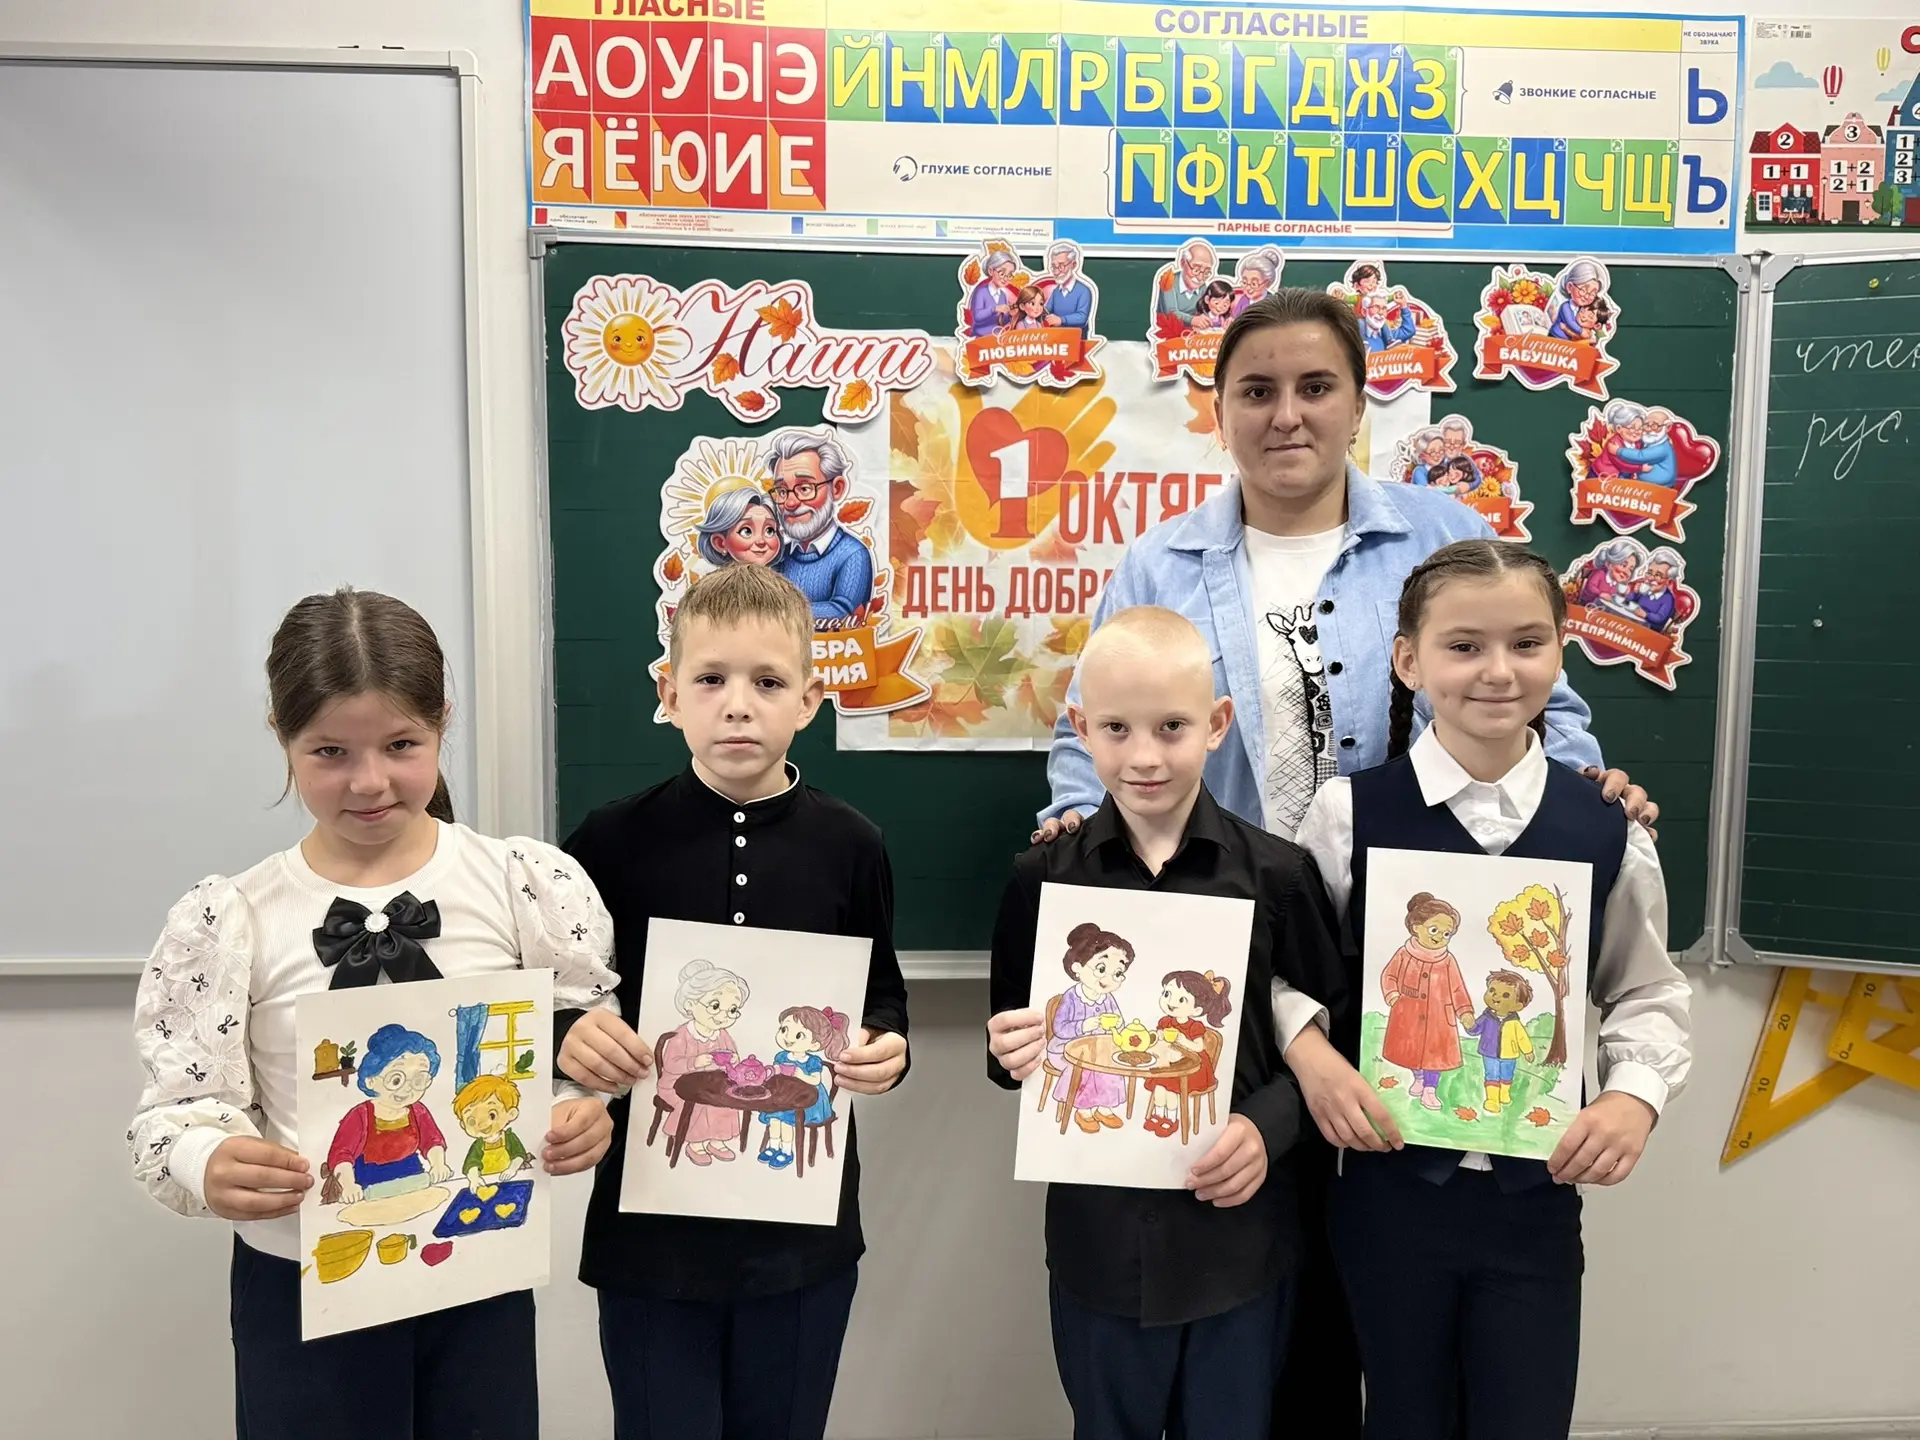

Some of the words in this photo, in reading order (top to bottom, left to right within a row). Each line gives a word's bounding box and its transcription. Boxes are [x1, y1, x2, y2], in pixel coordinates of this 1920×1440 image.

[1155, 9, 1369, 38] СОГЛАСНЫЕ
[1519, 87, 1577, 99] ЗВОНКИЕ
[1579, 88, 1657, 101] СОГЛАСНЫЕ
[1779, 133, 1792, 147] 2
[1846, 126, 1859, 139] 3
[920, 163, 970, 176] ГЛУХИЕ
[973, 165, 1053, 178] СОГЛАСНЫЕ
[1217, 222, 1271, 233] ПАРНЫЕ
[1273, 224, 1352, 235] СОГЛАСНЫЕ
[655, 288, 929, 380] Наши
[992, 325, 1049, 345] Самые
[1505, 329, 1577, 356] Лучшая
[978, 343, 1070, 362] ЛЮБИМЫЕ
[1168, 347, 1218, 362] КЛАСС
[1499, 347, 1579, 371] БАБУШКА
[1366, 361, 1424, 380] ДУШКА
[990, 439, 1036, 539] 1
[1598, 472, 1653, 499] Самые
[1586, 493, 1662, 516] КРАСИВЫЕ
[902, 565, 996, 619] ДЕНЬ
[1584, 602, 1635, 634] Самые
[811, 637, 864, 660] БРА
[1563, 617, 1660, 662] СТЕПРИИМНЫЕ
[1863, 982, 1877, 999] 10
[1777, 1013, 1791, 1032] 20
[1757, 1076, 1771, 1093] 10
